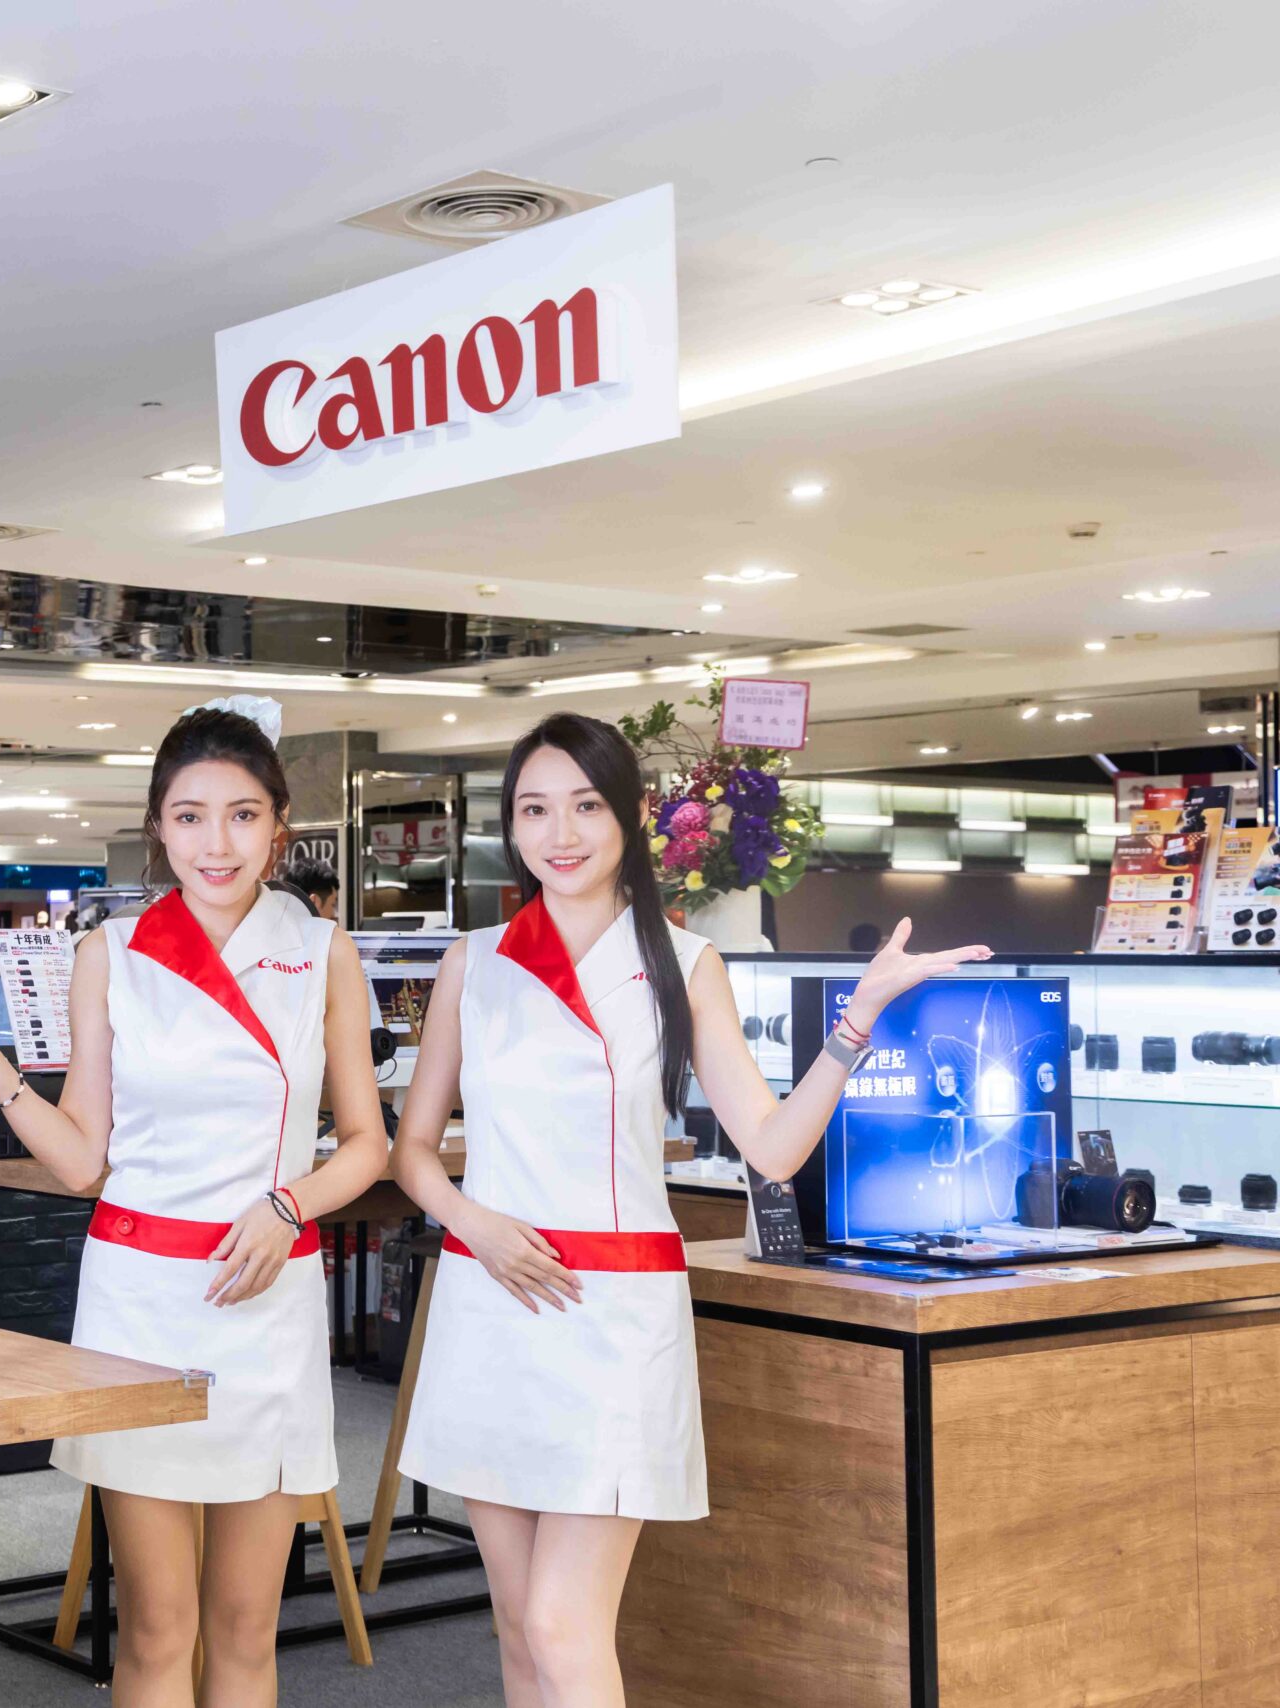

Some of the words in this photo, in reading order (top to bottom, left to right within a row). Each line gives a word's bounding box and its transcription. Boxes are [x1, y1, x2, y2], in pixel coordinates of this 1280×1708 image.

[240, 287, 600, 467] Canon
[14, 934, 53, 946] 十年有成
[257, 957, 313, 974] Canon
[1040, 992, 1062, 1003] EOS
